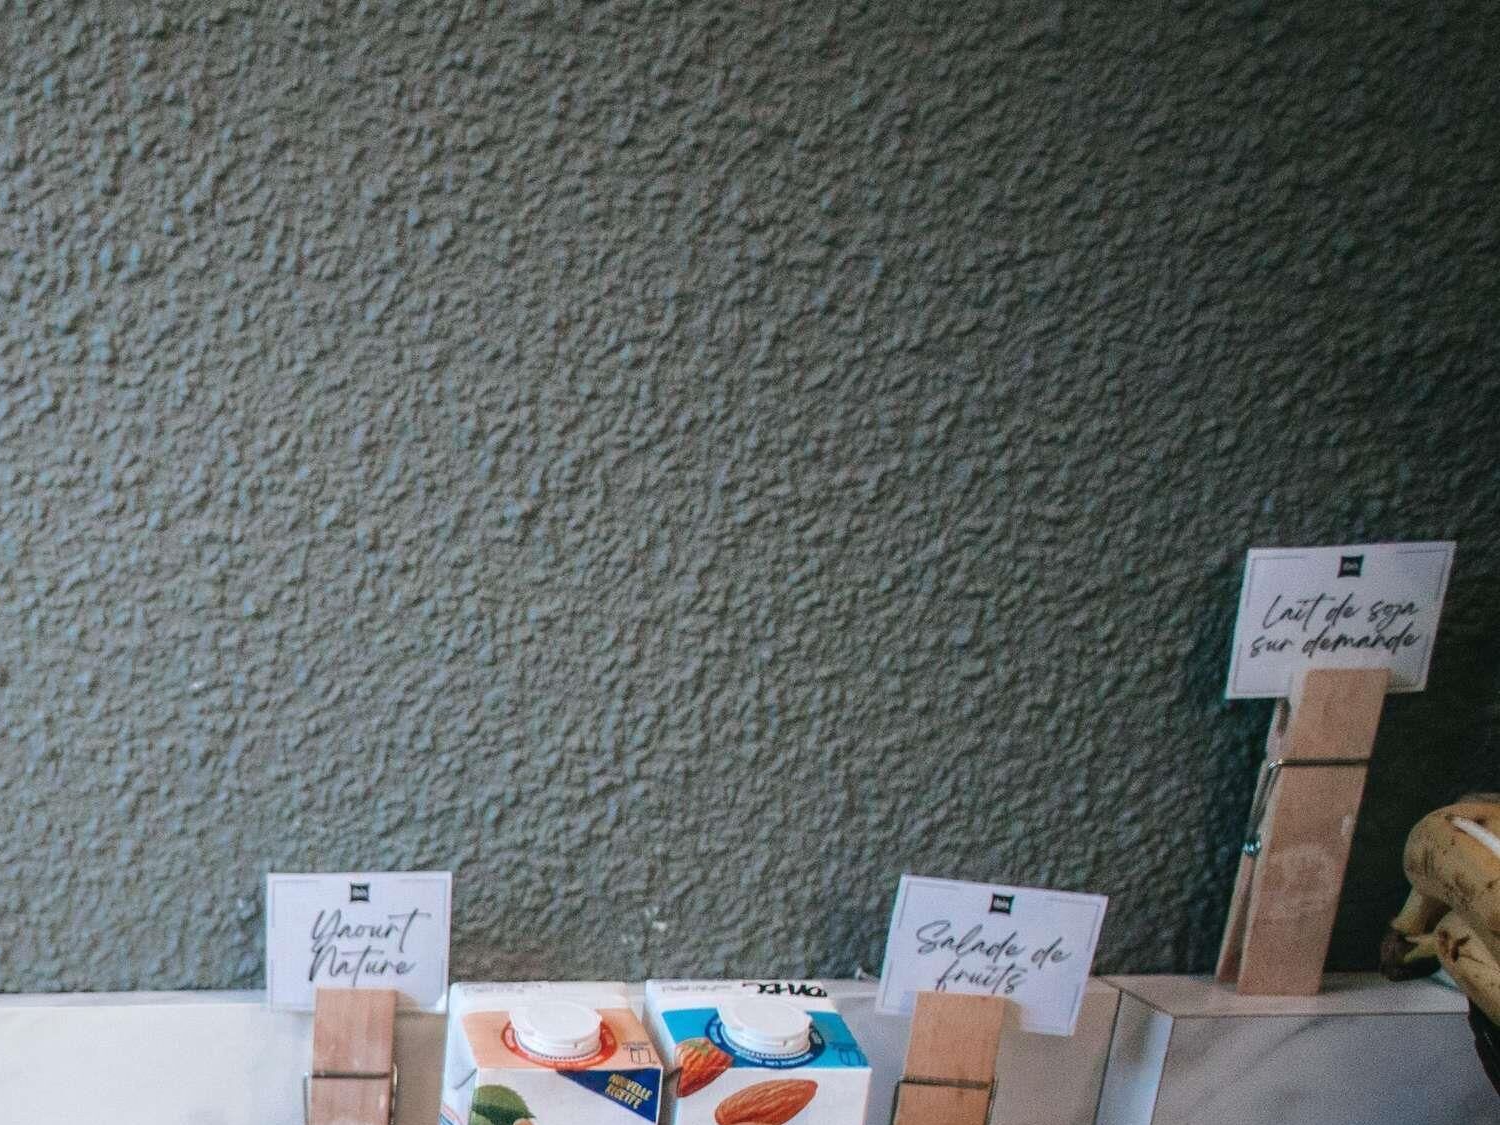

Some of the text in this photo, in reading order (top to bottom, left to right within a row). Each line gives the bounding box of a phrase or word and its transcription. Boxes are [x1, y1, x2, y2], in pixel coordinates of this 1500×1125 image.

[1263, 593, 1336, 632] Lait
[1325, 592, 1361, 628] de
[1251, 621, 1421, 658] sur demande
[311, 908, 431, 953] Yaourt
[916, 919, 1072, 969] Salade de
[309, 945, 415, 988] Nature
[935, 959, 1028, 994] fruits
